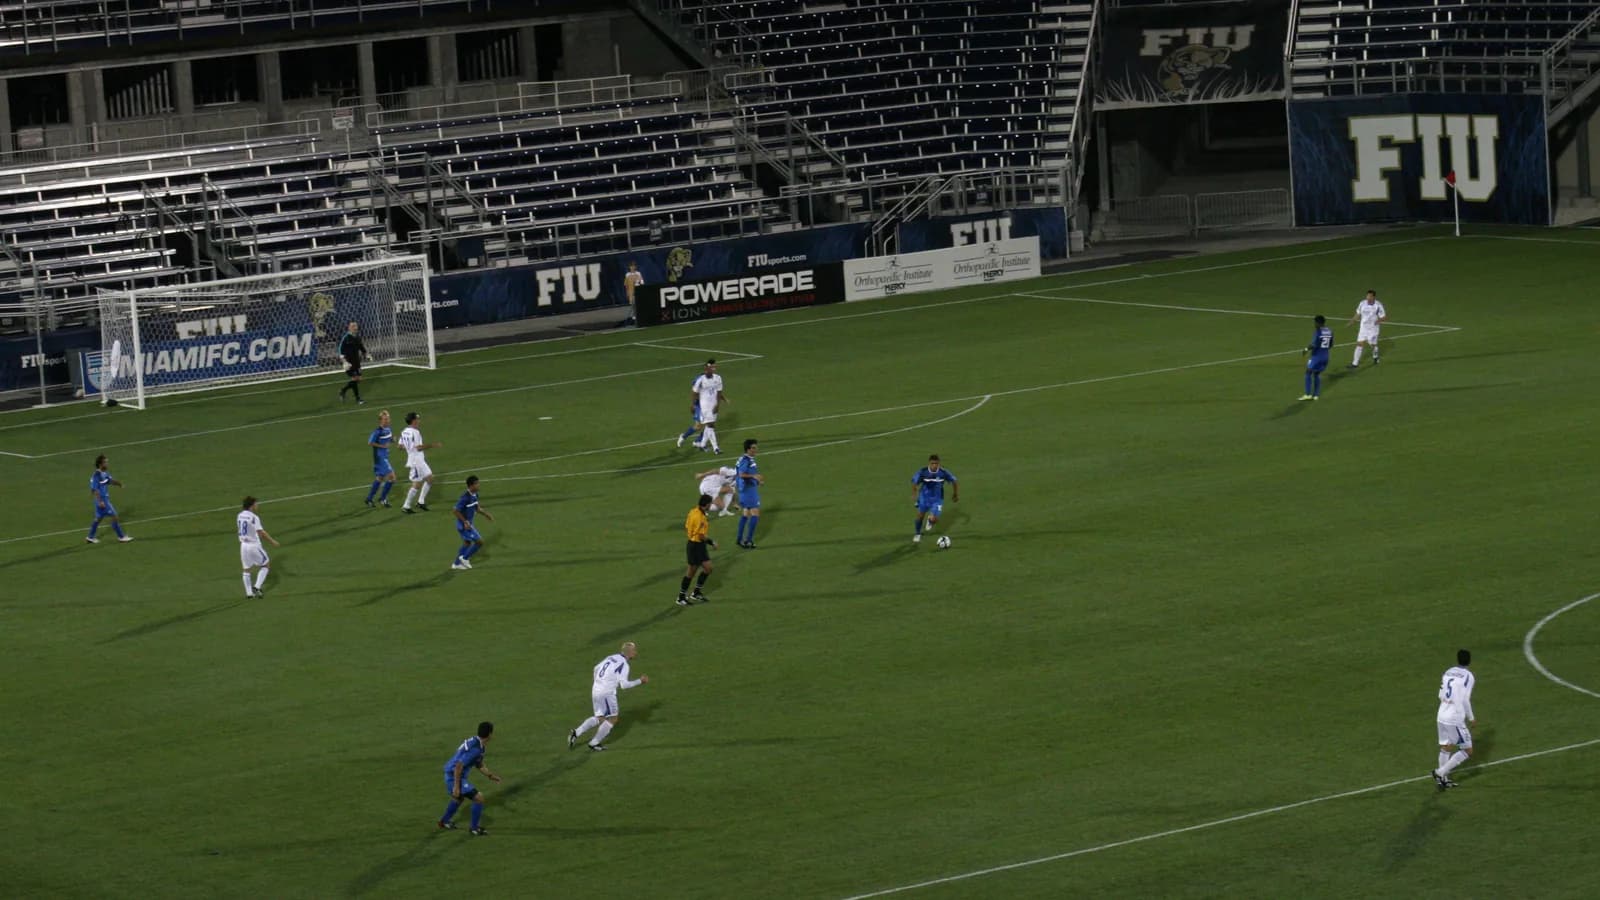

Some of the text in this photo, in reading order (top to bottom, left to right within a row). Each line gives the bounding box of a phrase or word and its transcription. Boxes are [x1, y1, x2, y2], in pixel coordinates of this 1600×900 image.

[1139, 24, 1255, 57] FIU
[1347, 113, 1499, 202] FIU
[950, 217, 1012, 248] FIU
[747, 253, 807, 268] FIUsports.com
[536, 263, 602, 307] FIU
[660, 270, 815, 308] POWERADE
[598, 661, 611, 678] 8
[1445, 678, 1455, 699] 5
